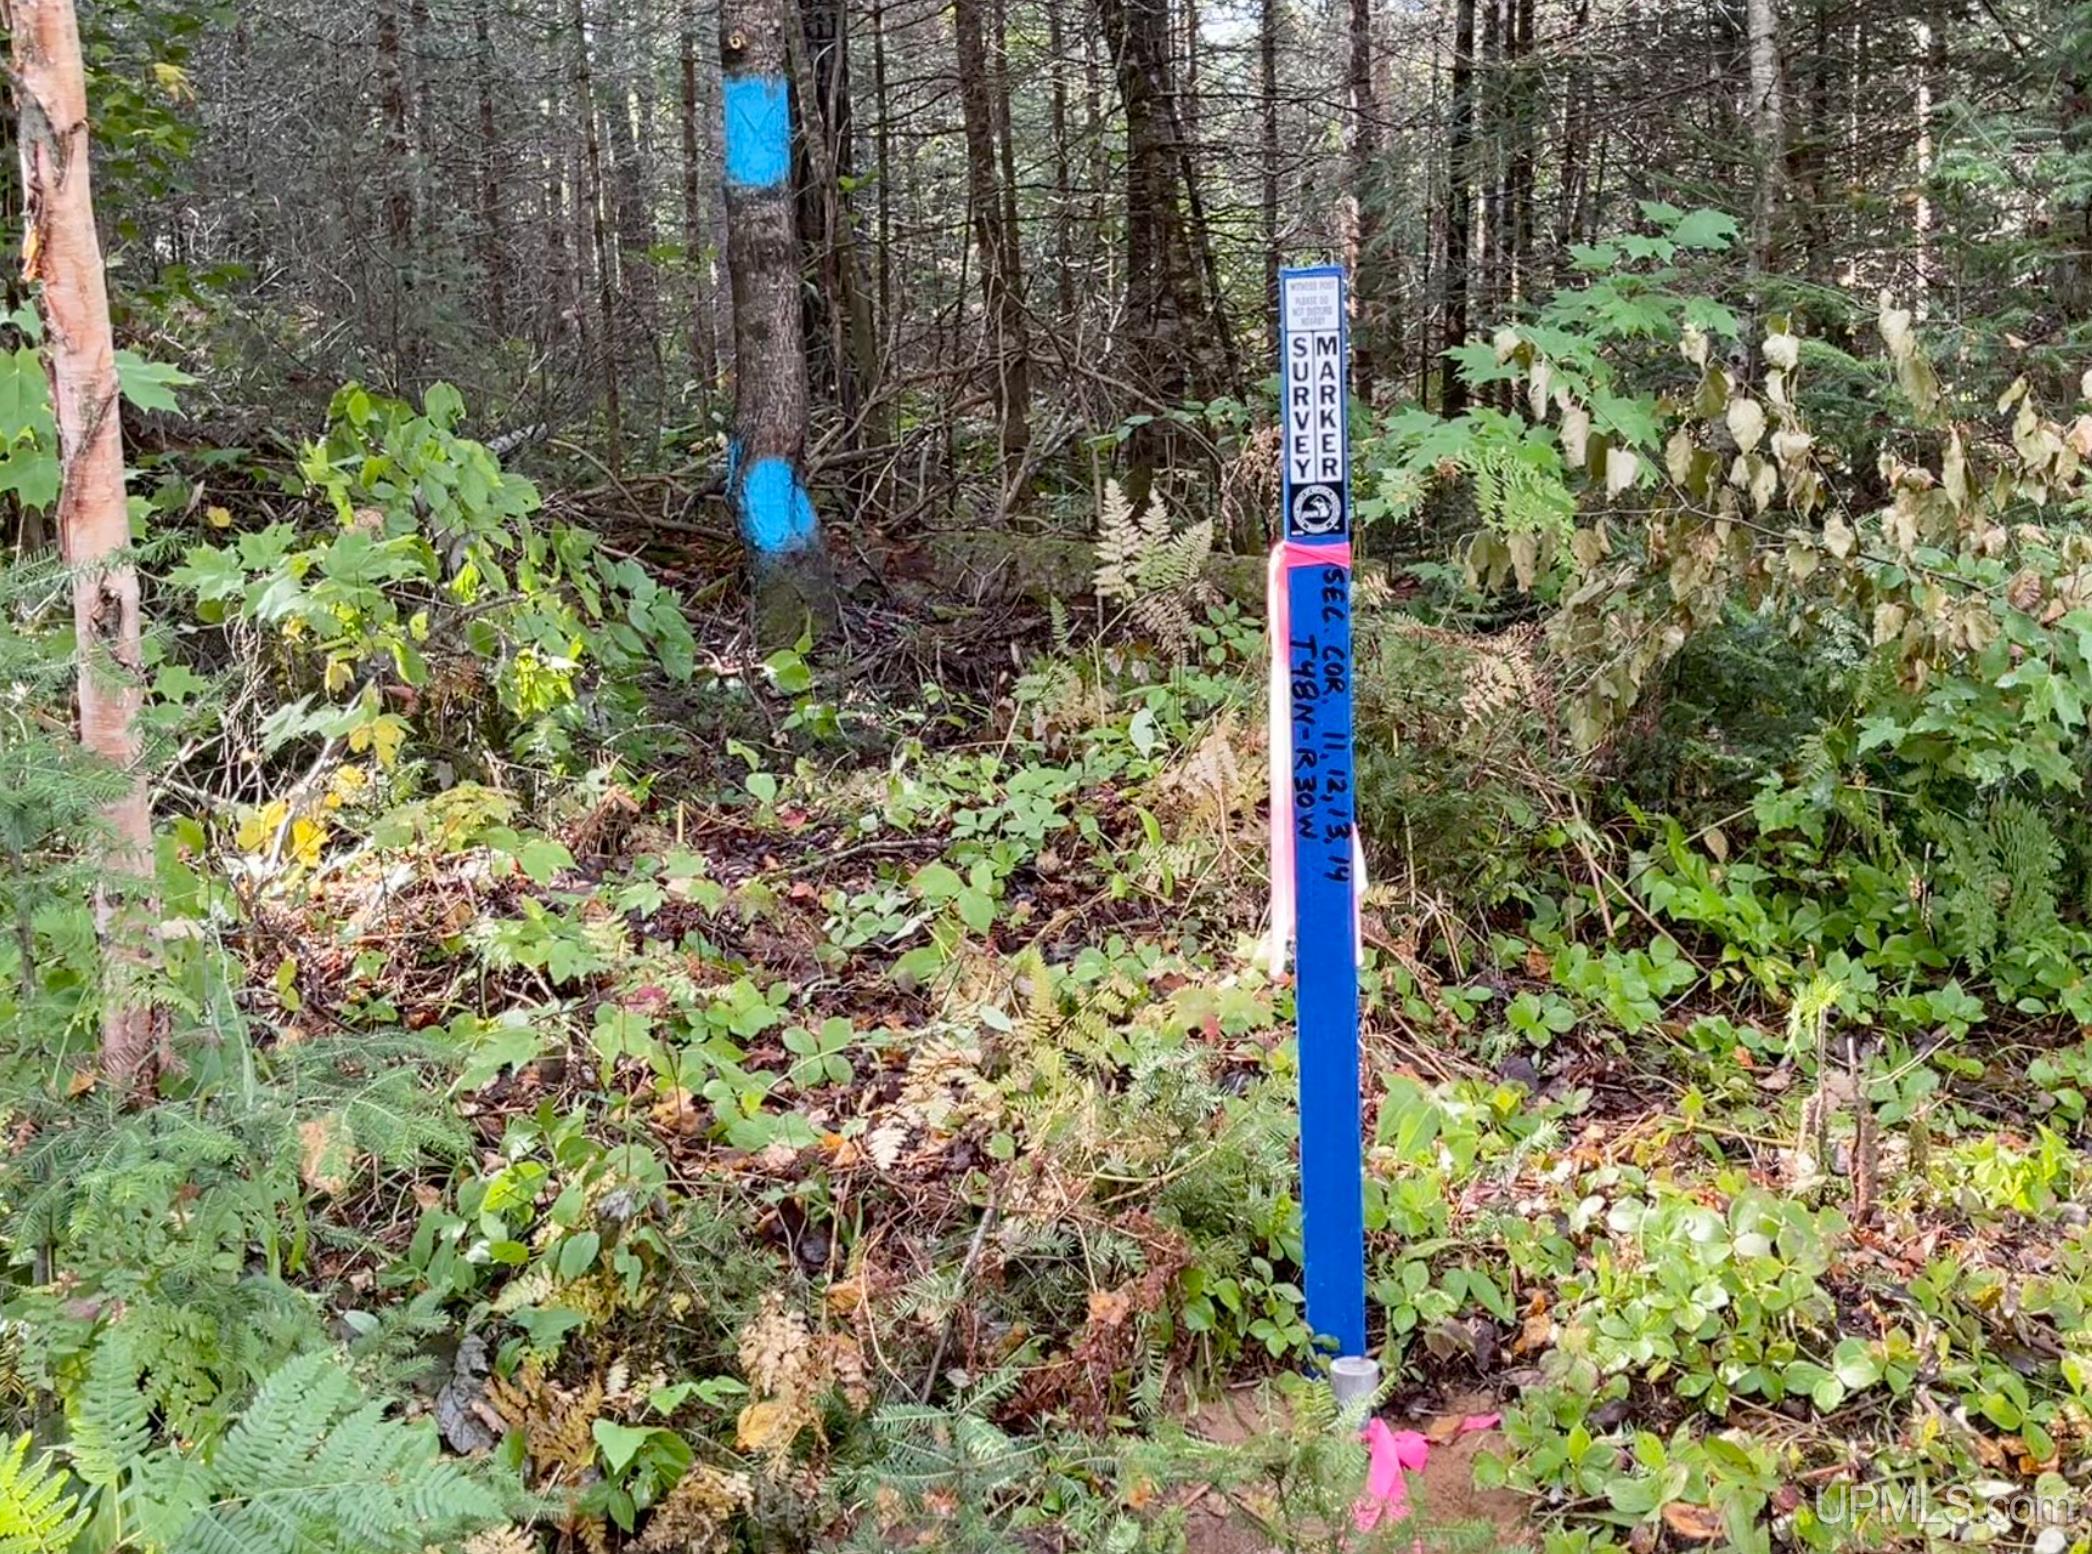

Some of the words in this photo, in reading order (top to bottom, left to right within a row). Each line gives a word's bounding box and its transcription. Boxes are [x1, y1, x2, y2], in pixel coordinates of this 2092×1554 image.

[1293, 337, 1311, 479] SURVEY
[1317, 336, 1338, 477] MARKER
[1325, 855, 1351, 883] 14
